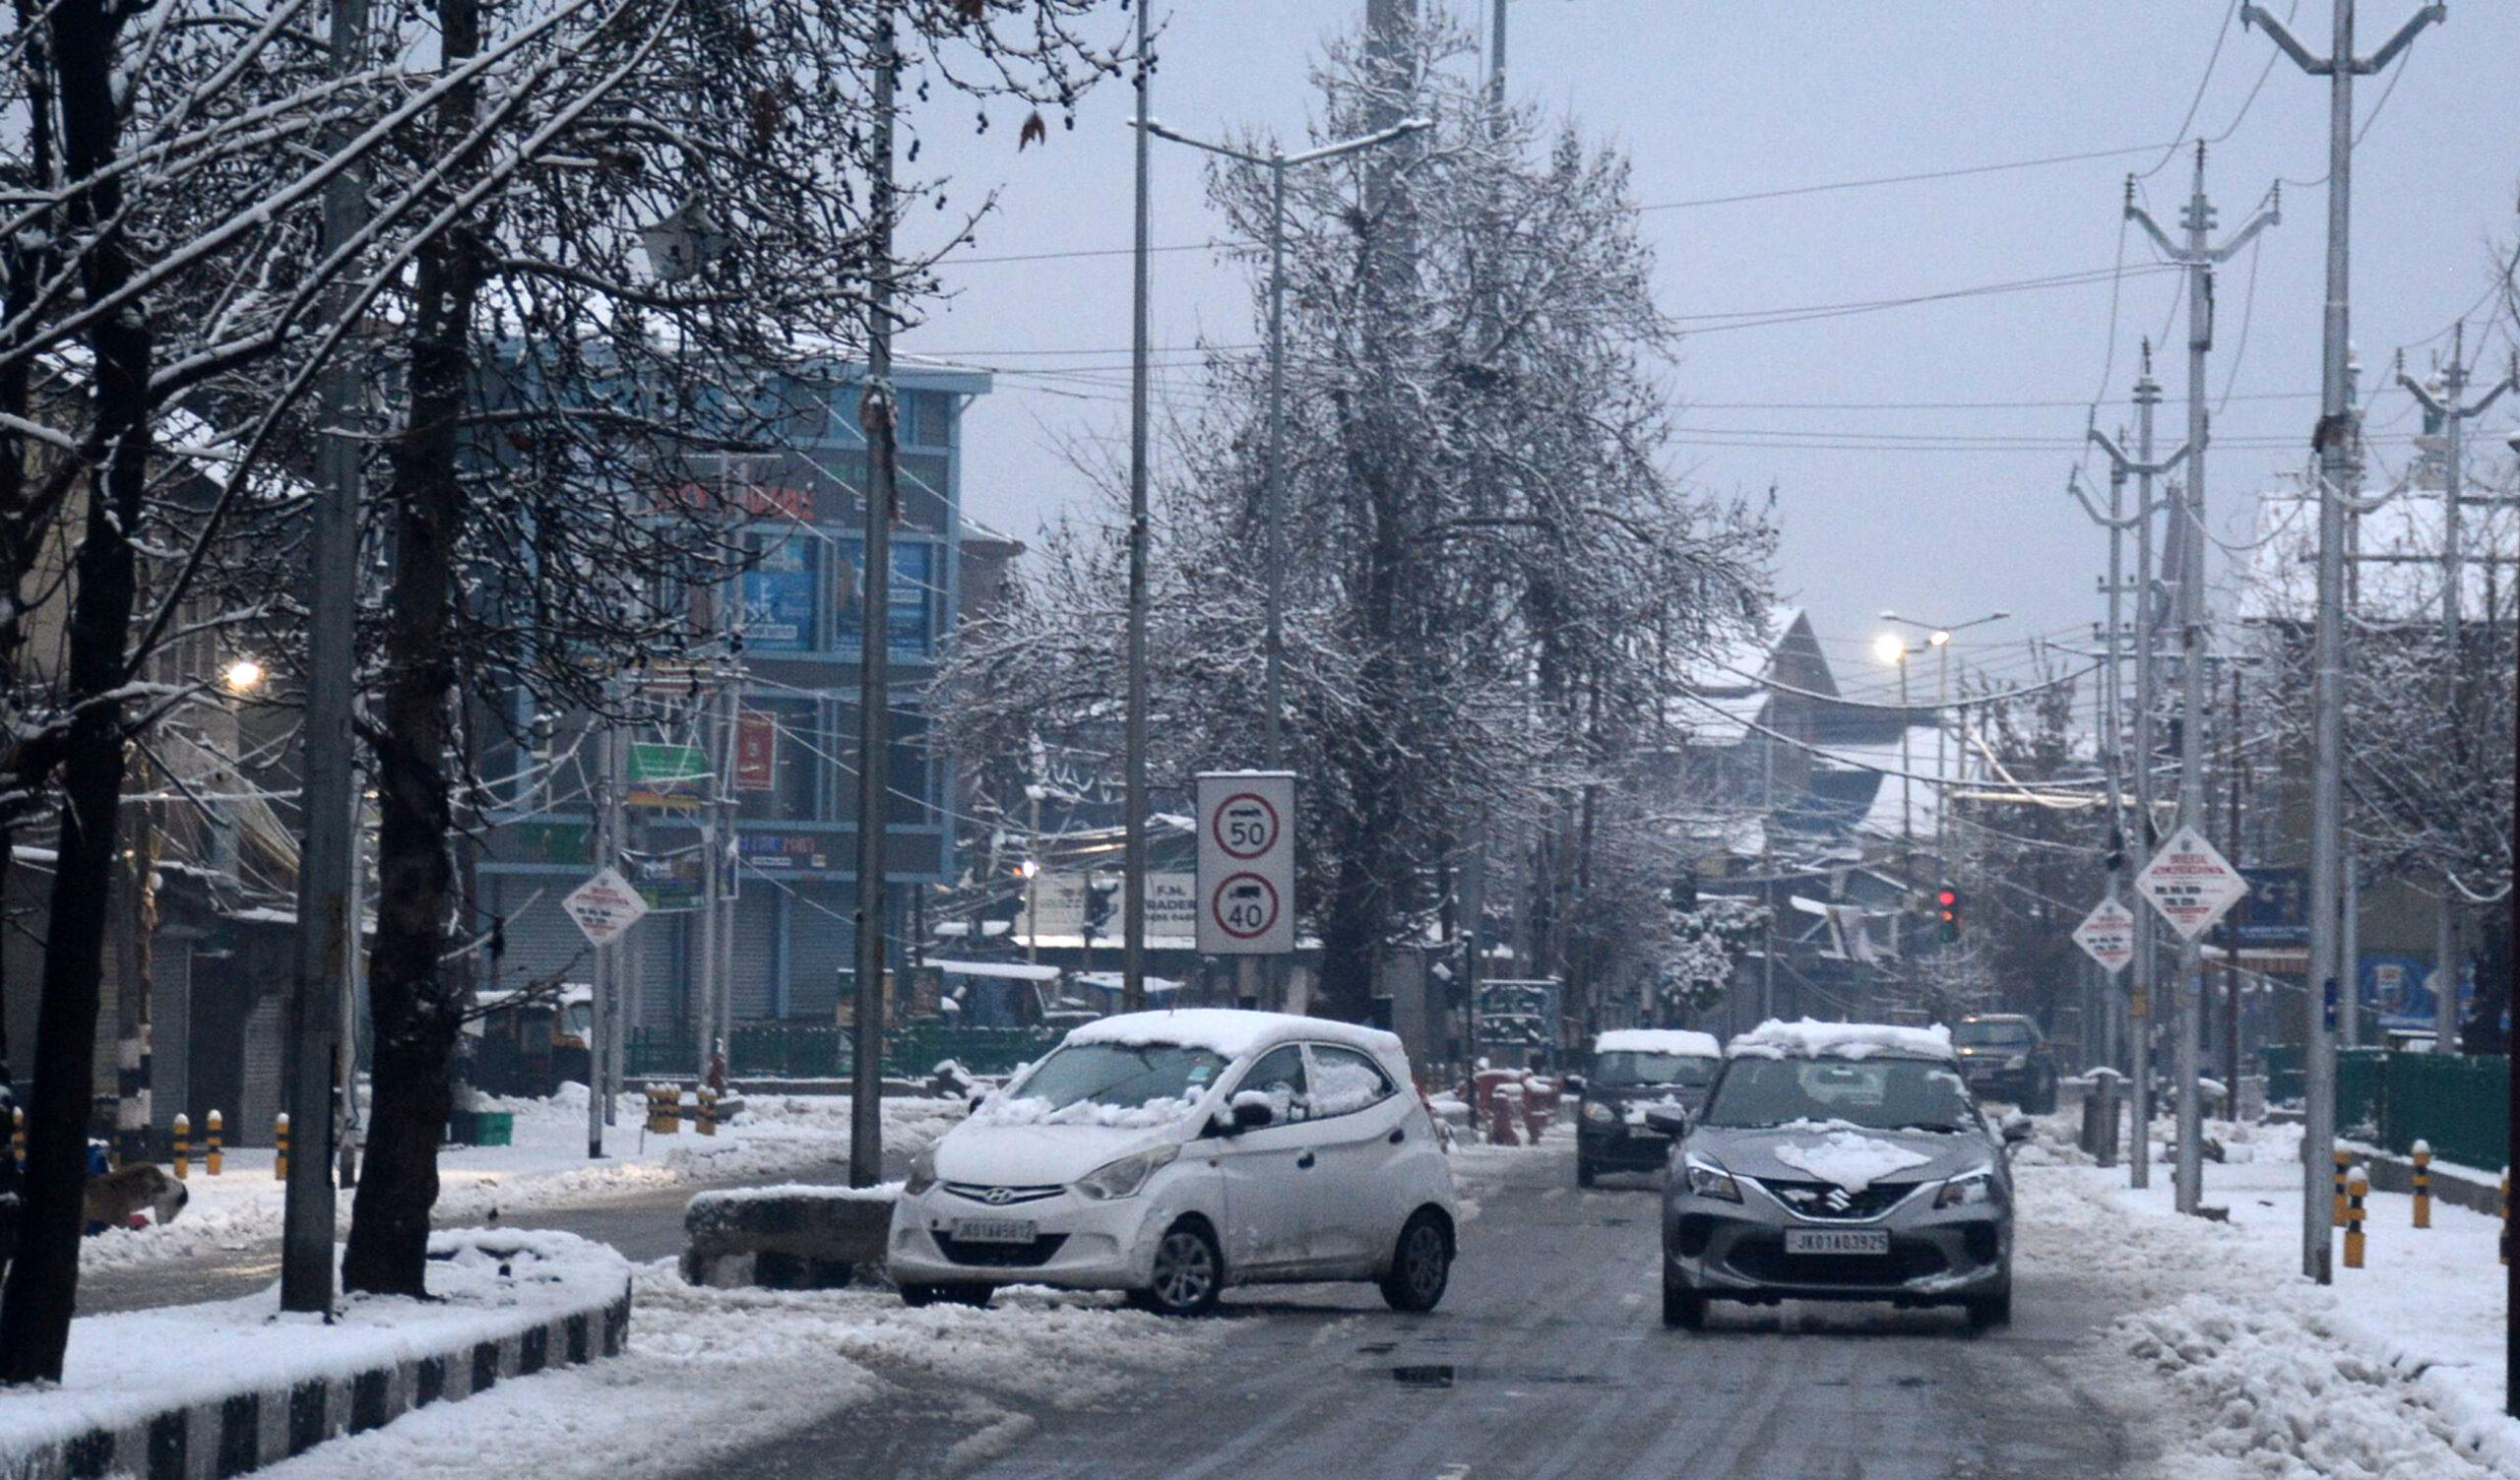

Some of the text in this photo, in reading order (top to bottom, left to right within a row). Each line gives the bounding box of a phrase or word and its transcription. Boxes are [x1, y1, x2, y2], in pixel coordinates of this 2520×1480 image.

[1230, 823, 1265, 846] 50
[1145, 899, 1198, 910] RADER
[1228, 904, 1263, 928] 40
